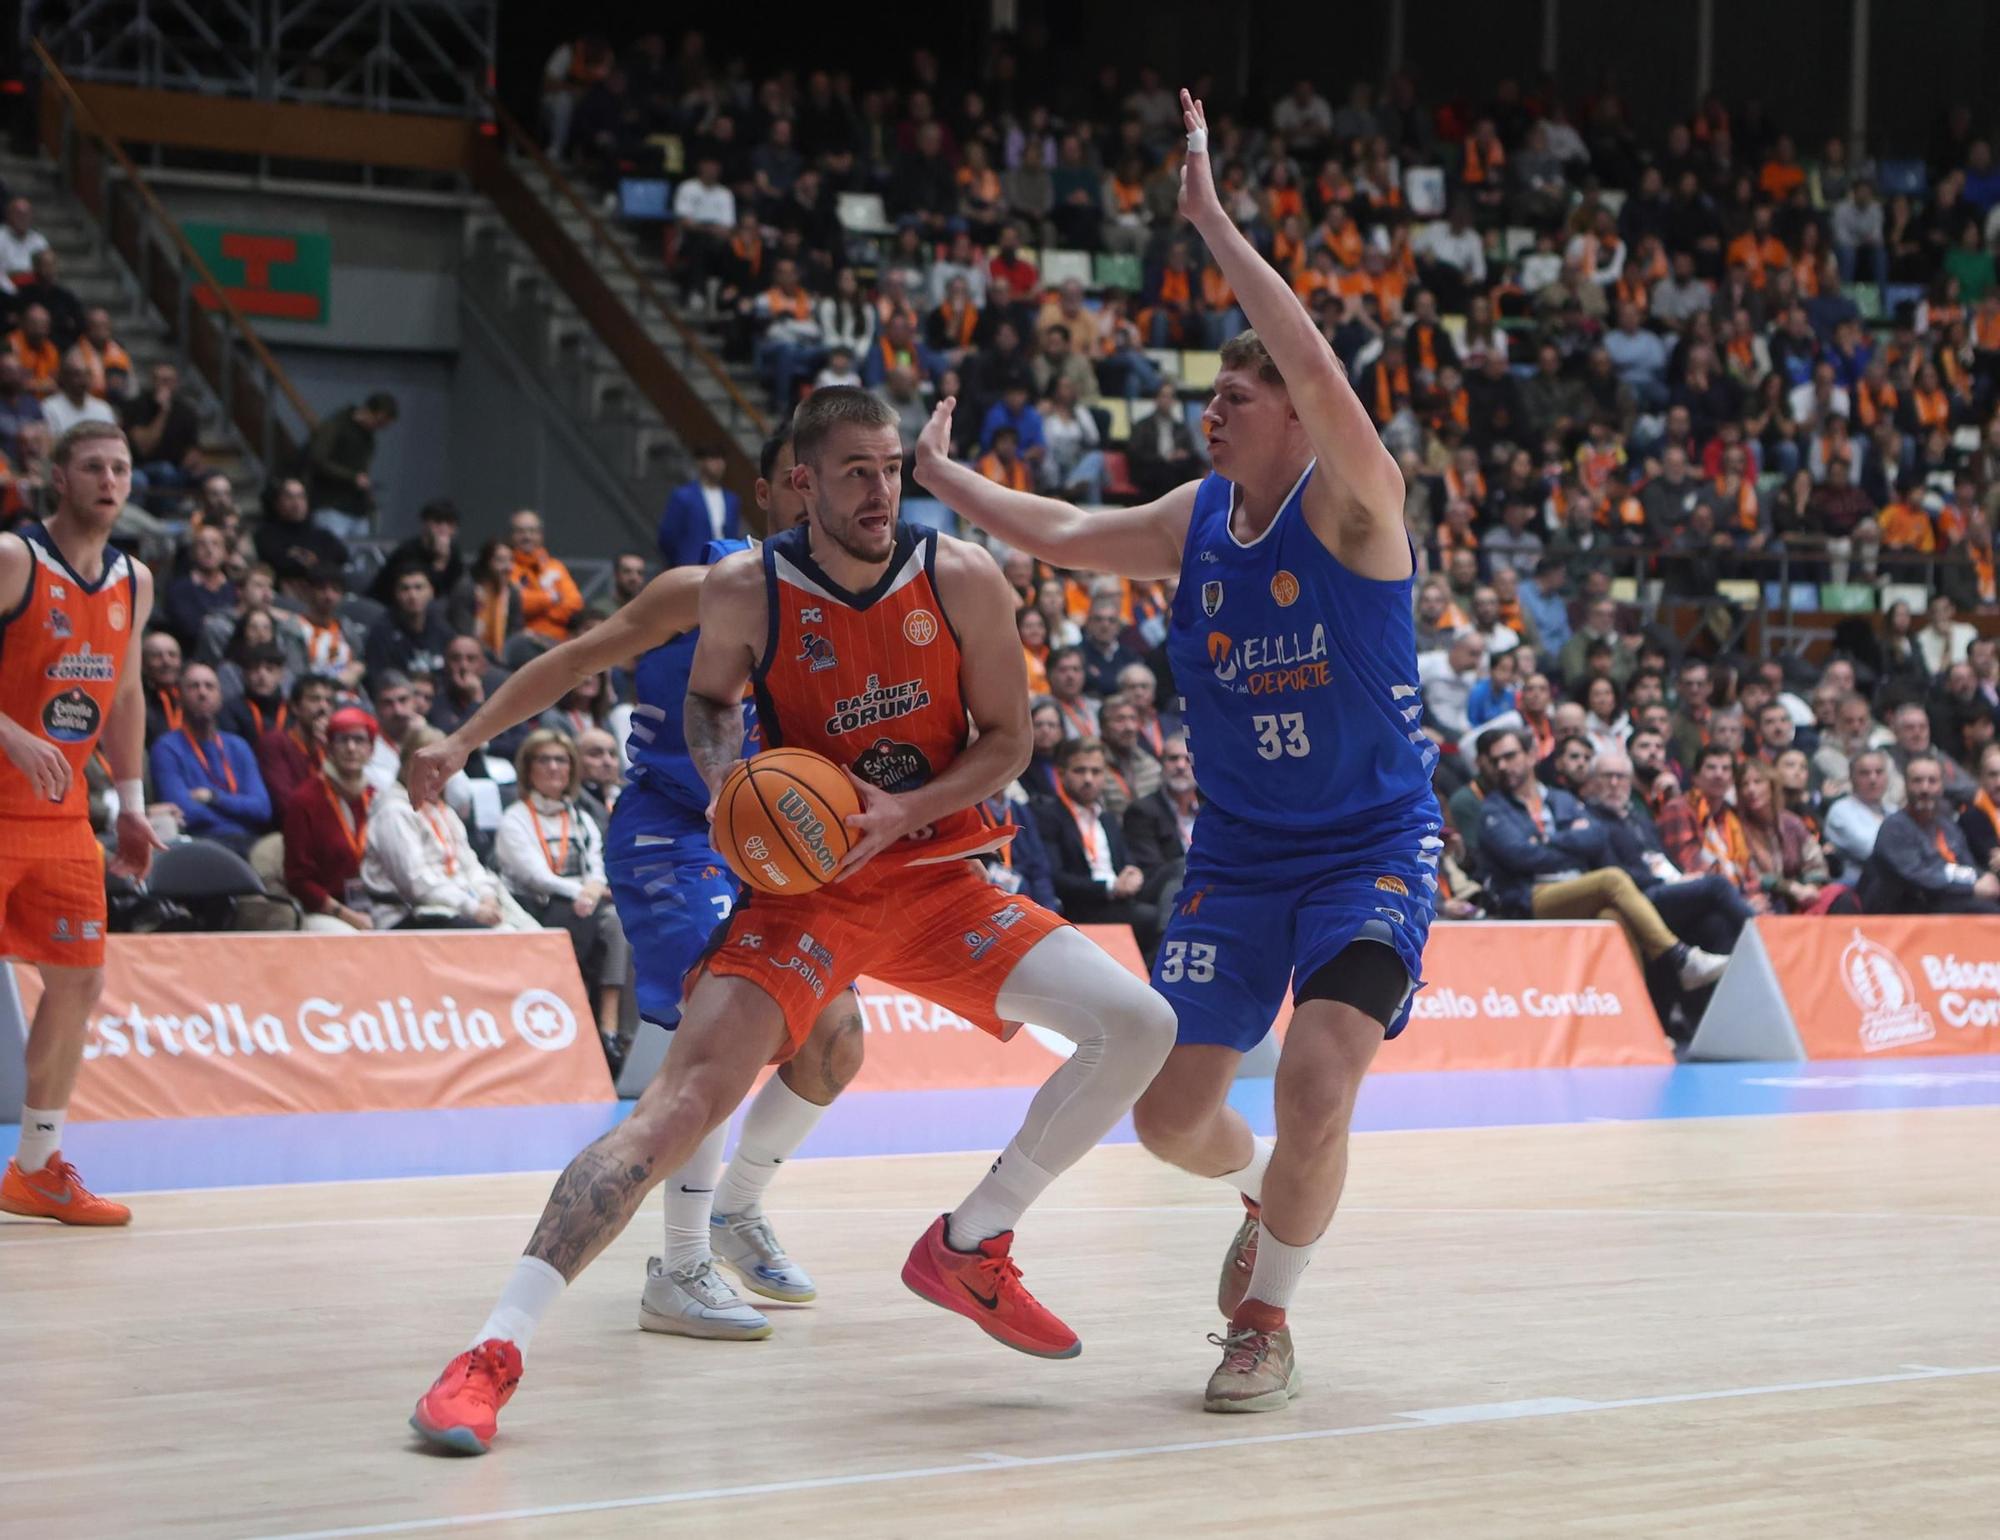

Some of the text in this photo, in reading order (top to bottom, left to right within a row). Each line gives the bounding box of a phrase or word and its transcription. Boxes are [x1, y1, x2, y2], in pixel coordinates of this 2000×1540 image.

[1247, 661, 1334, 696] DEPORTE
[1252, 712, 1311, 761] 33
[776, 786, 837, 876] Wilson
[1161, 941, 1217, 983] 33
[1482, 987, 1520, 1017] da
[1522, 987, 1622, 1017] Coruña
[83, 995, 505, 1060] strella Galicia
